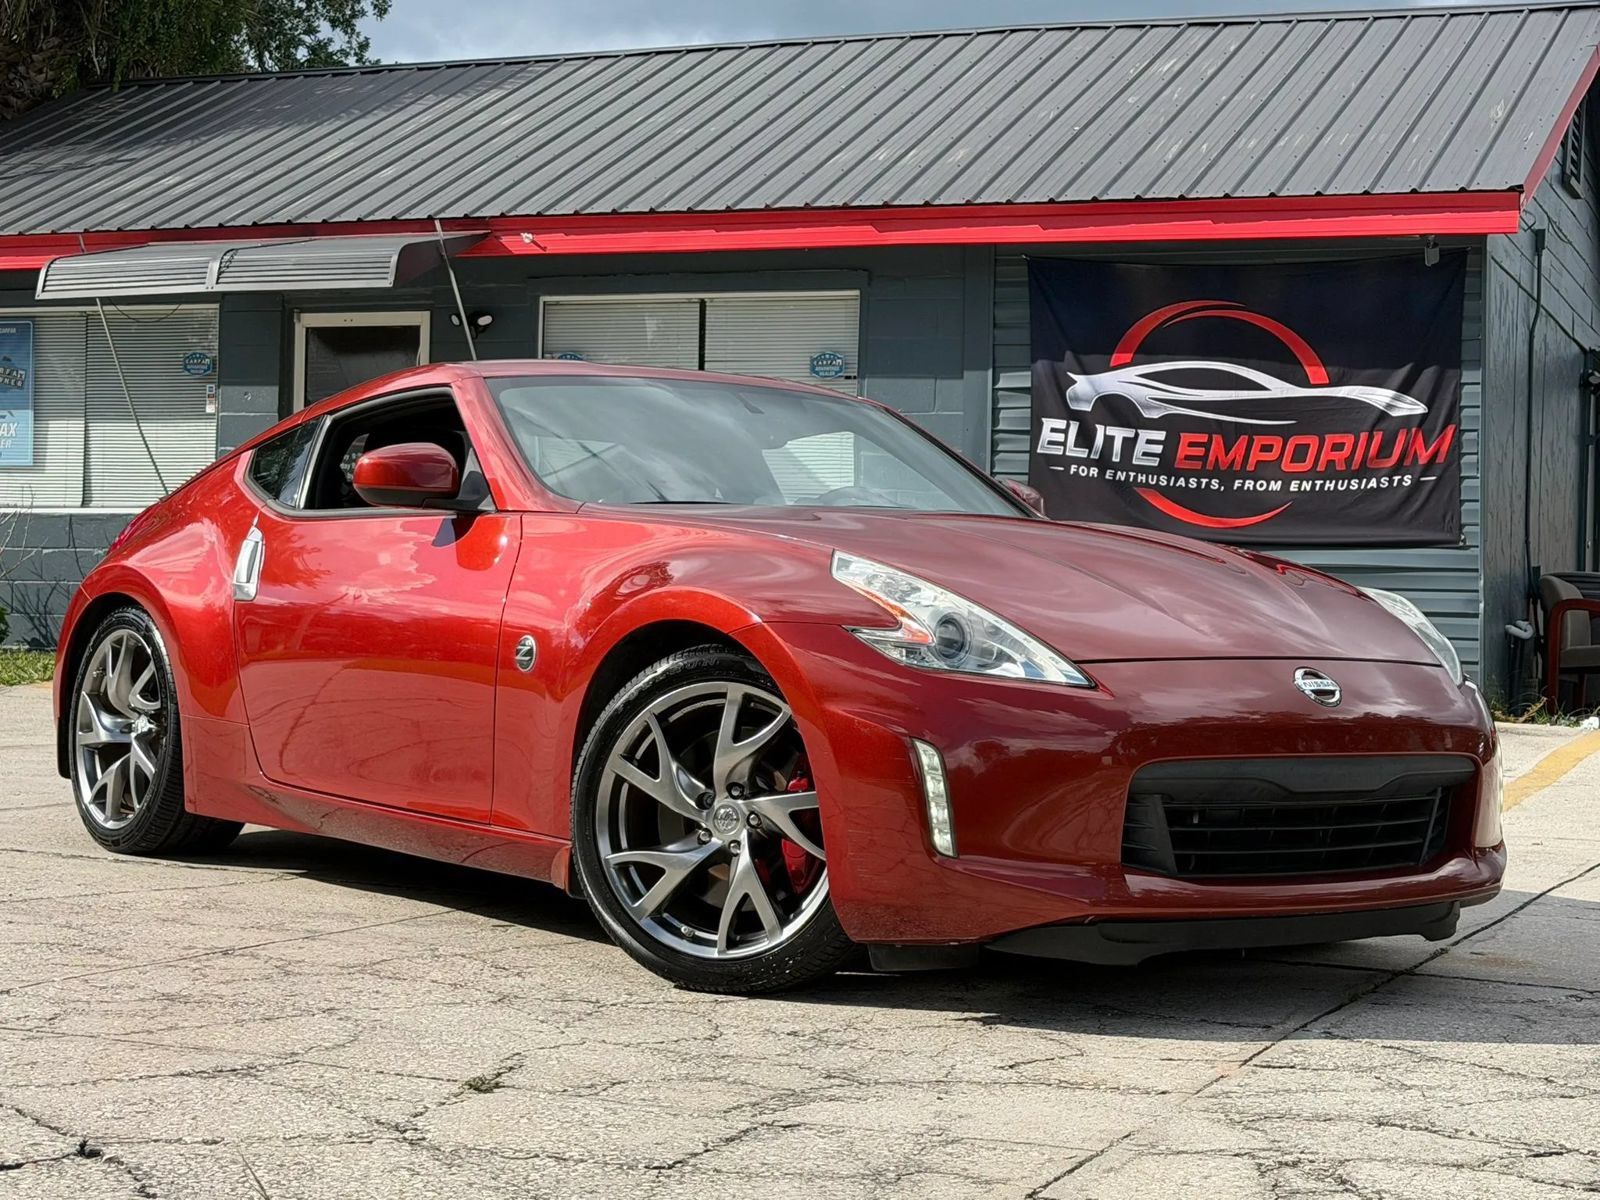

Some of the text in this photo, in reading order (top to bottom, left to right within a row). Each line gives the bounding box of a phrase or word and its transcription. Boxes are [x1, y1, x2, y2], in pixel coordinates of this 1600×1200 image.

[1036, 417, 1456, 473] ELITE EMPORIUM
[1070, 464, 1413, 492] FOR ENTHUSIASTS, FROM ENTHUSIASTS
